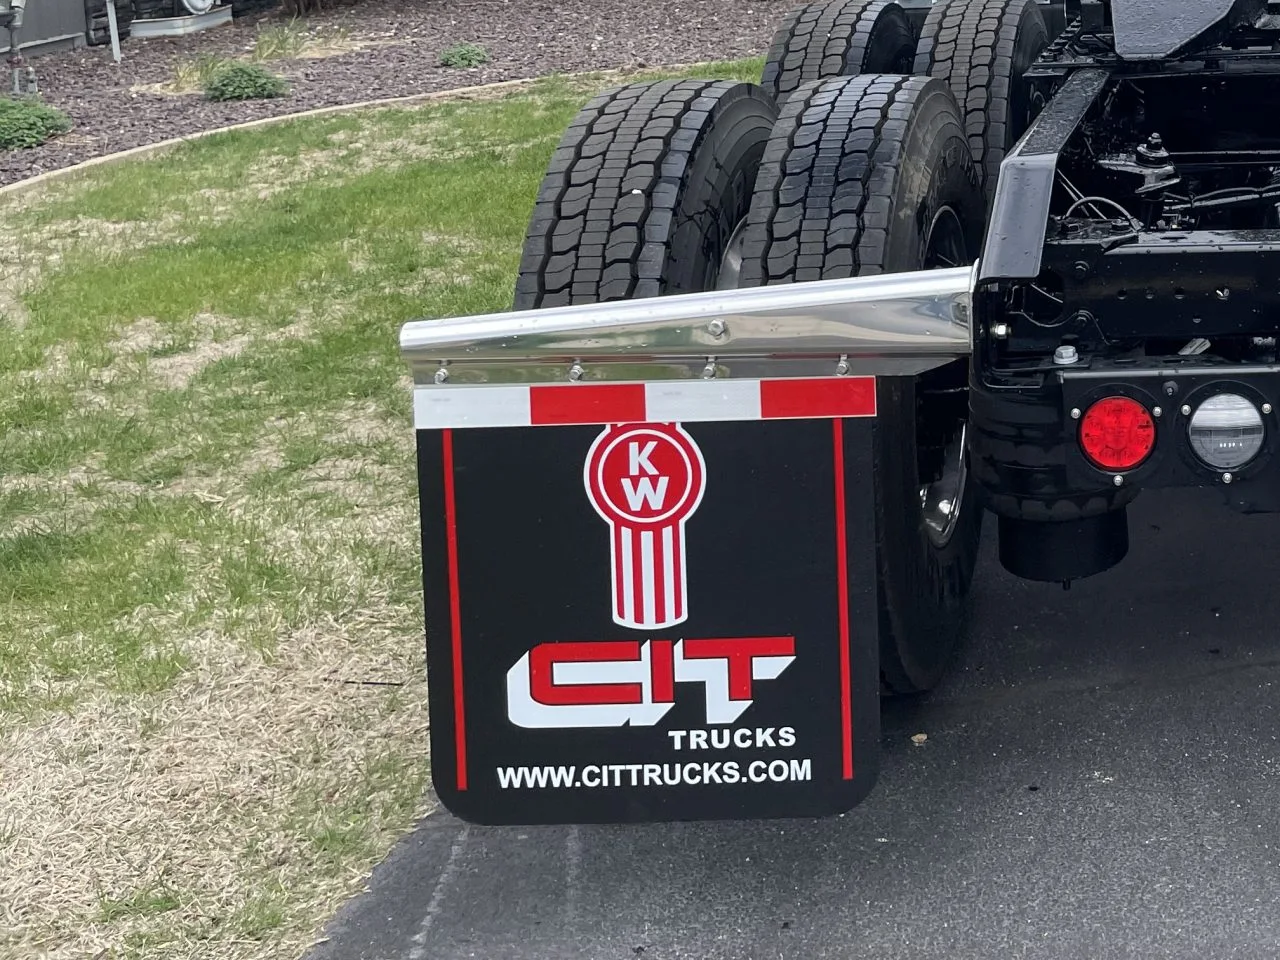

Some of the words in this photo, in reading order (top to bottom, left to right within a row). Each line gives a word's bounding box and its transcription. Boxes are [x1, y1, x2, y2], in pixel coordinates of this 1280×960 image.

[507, 636, 796, 728] CIT
[668, 726, 797, 750] TRUCKS
[496, 758, 812, 789] WWW.CITTRUCKS.COM
